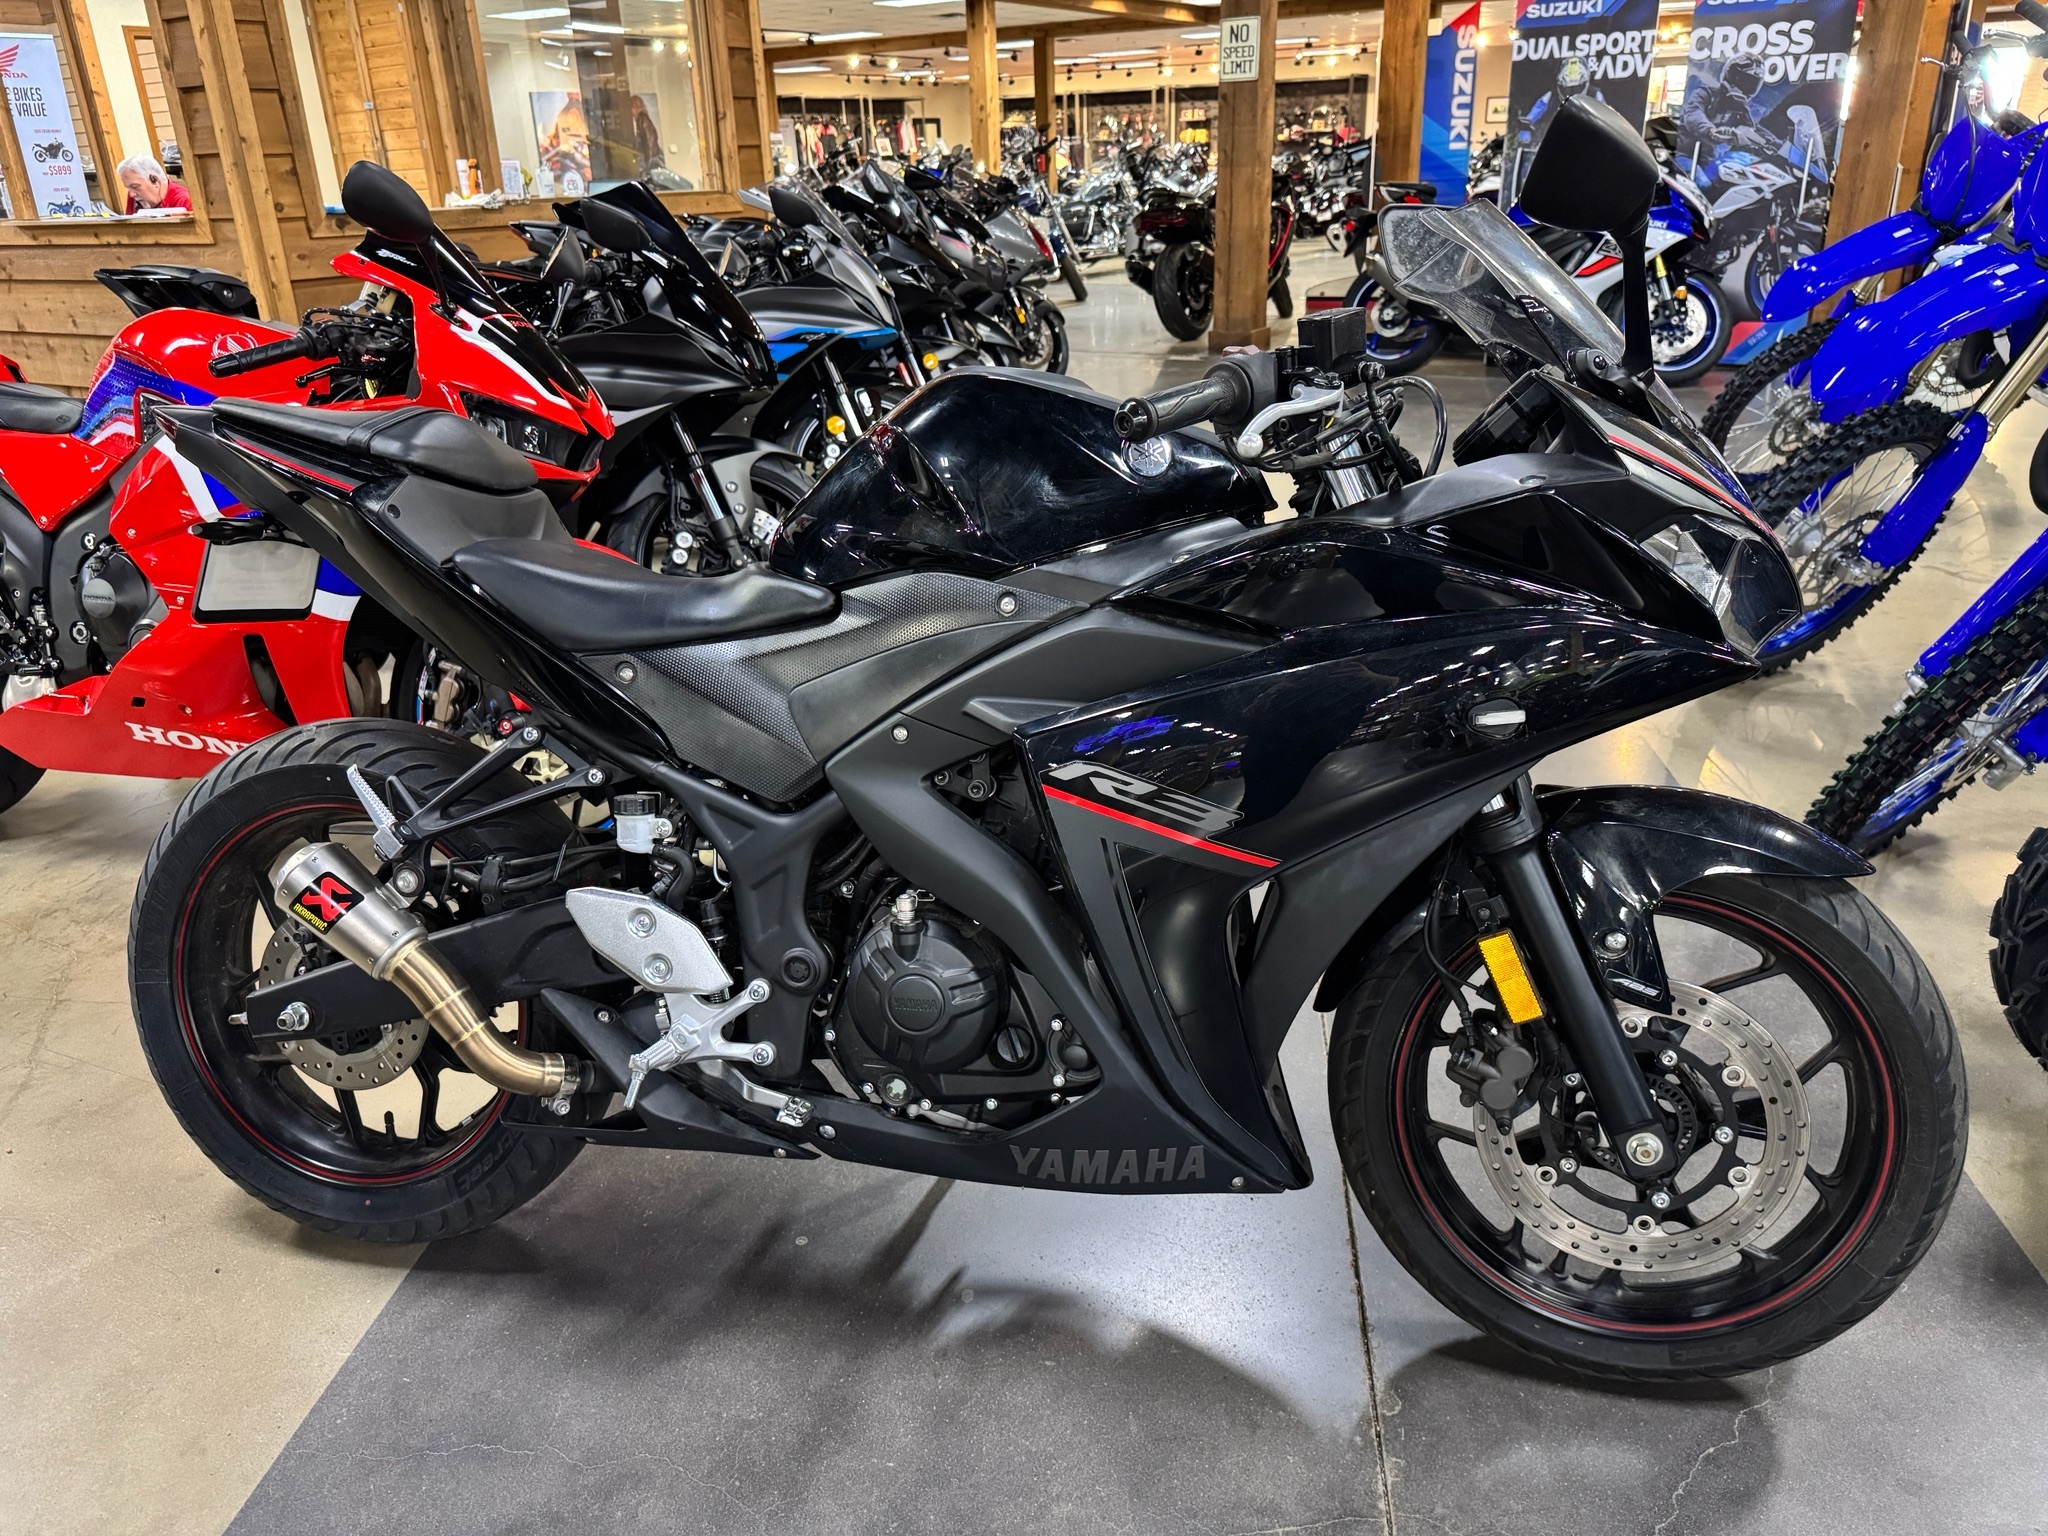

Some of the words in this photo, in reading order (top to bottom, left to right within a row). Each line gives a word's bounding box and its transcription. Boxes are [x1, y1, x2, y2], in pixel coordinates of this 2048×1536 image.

[1526, 0, 1603, 18] SUZUKI
[1229, 24, 1249, 43] NO
[1688, 20, 1816, 60] CROSS
[1223, 45, 1255, 59] SPEED
[1223, 59, 1254, 75] LIMIT
[1764, 52, 1850, 83] OVER
[12, 87, 43, 102] BIKES
[1449, 24, 1478, 150] SUZUKI
[15, 103, 48, 117] VALUE
[1648, 219, 1668, 229] UKI
[83, 594, 116, 603] HONDA
[124, 721, 250, 757] HON
[1049, 761, 1242, 832] R3
[1607, 978, 1661, 997] ABS
[892, 996, 939, 1012] YAMAHA
[1009, 1144, 1206, 1185] YAMAHA
